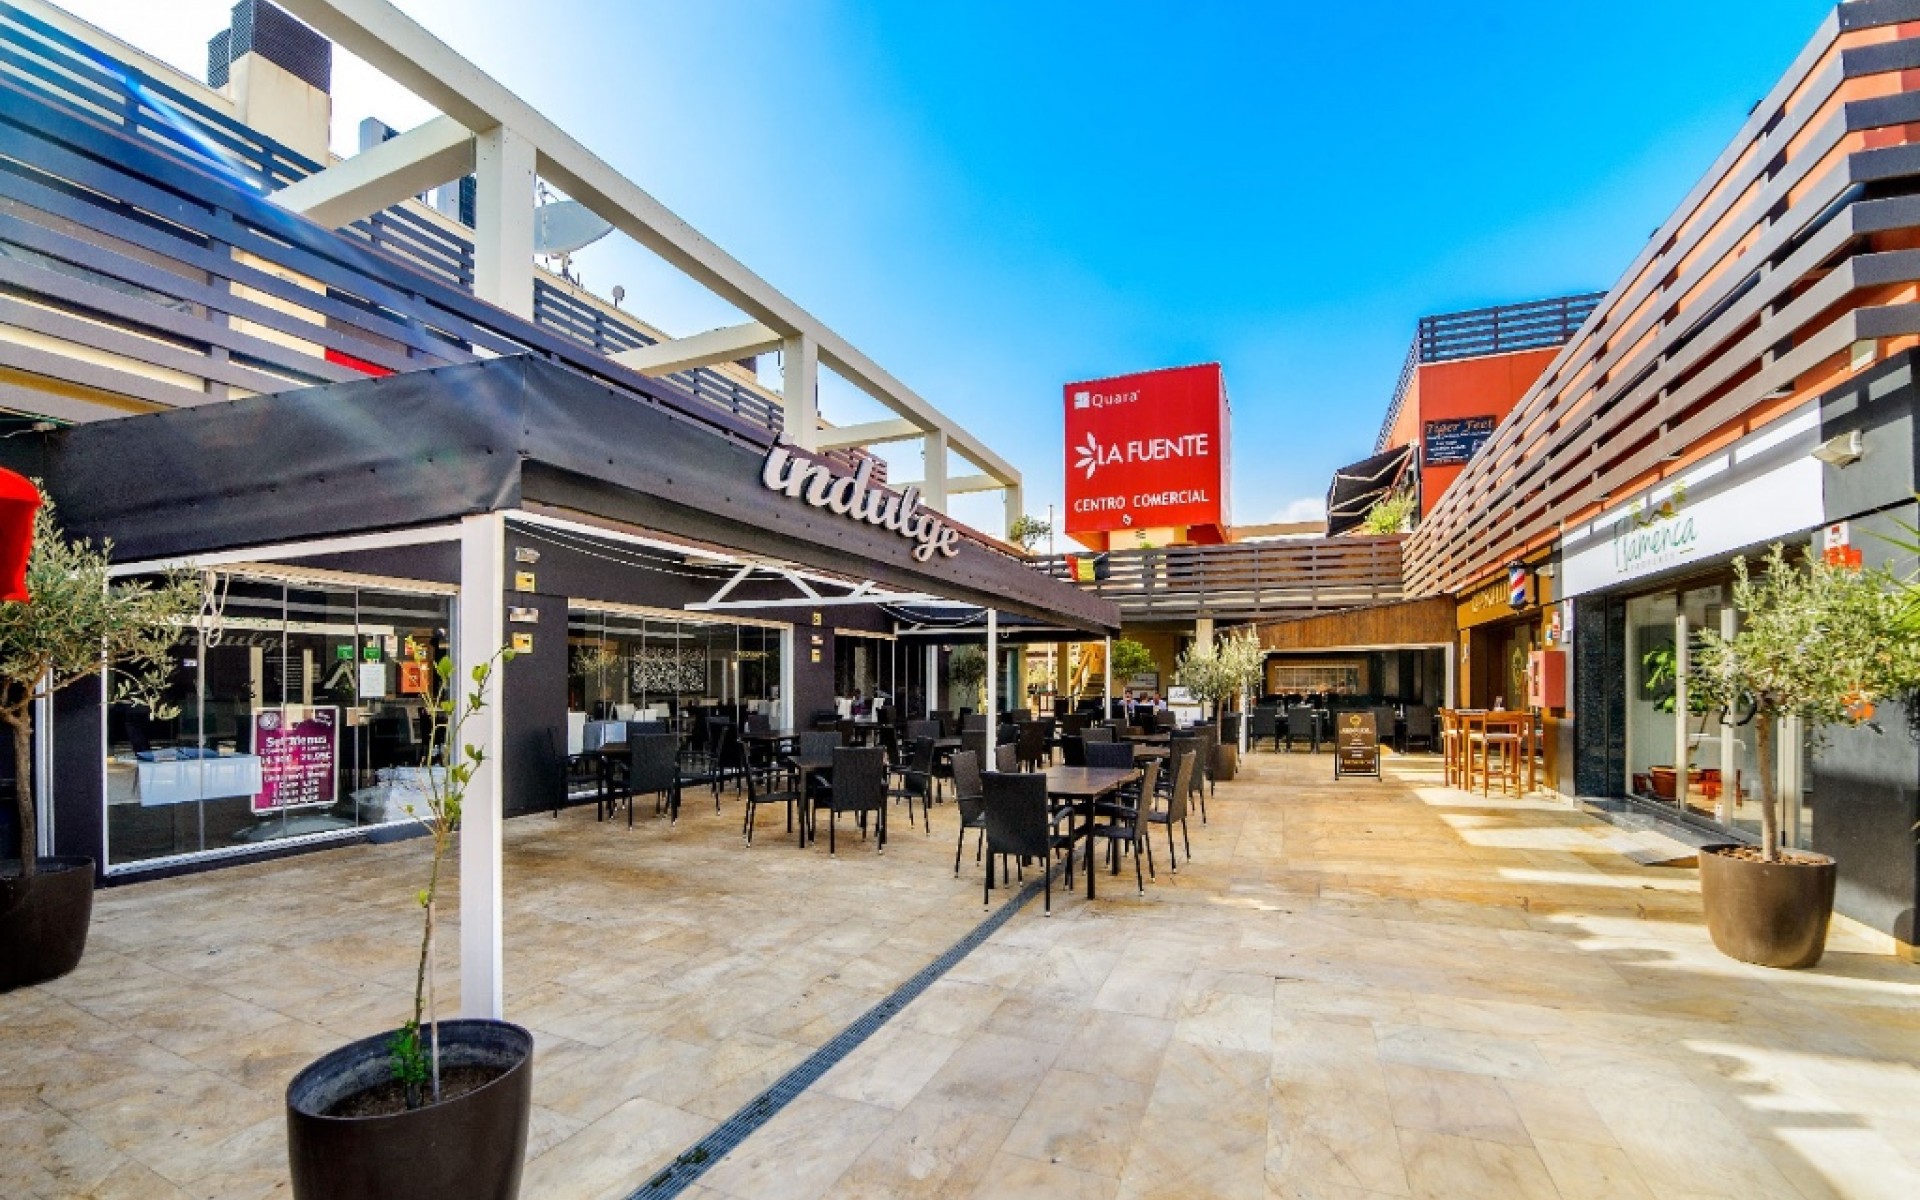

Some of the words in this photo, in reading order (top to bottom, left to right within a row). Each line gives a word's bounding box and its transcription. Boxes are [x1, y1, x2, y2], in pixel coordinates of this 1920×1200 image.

[1092, 391, 1138, 408] Quara
[1097, 443, 1123, 465] LA
[1128, 433, 1208, 463] FUENTE
[763, 432, 959, 562] indulge
[1074, 496, 1126, 513] CENTRO
[1133, 490, 1209, 509] COMERCIAL
